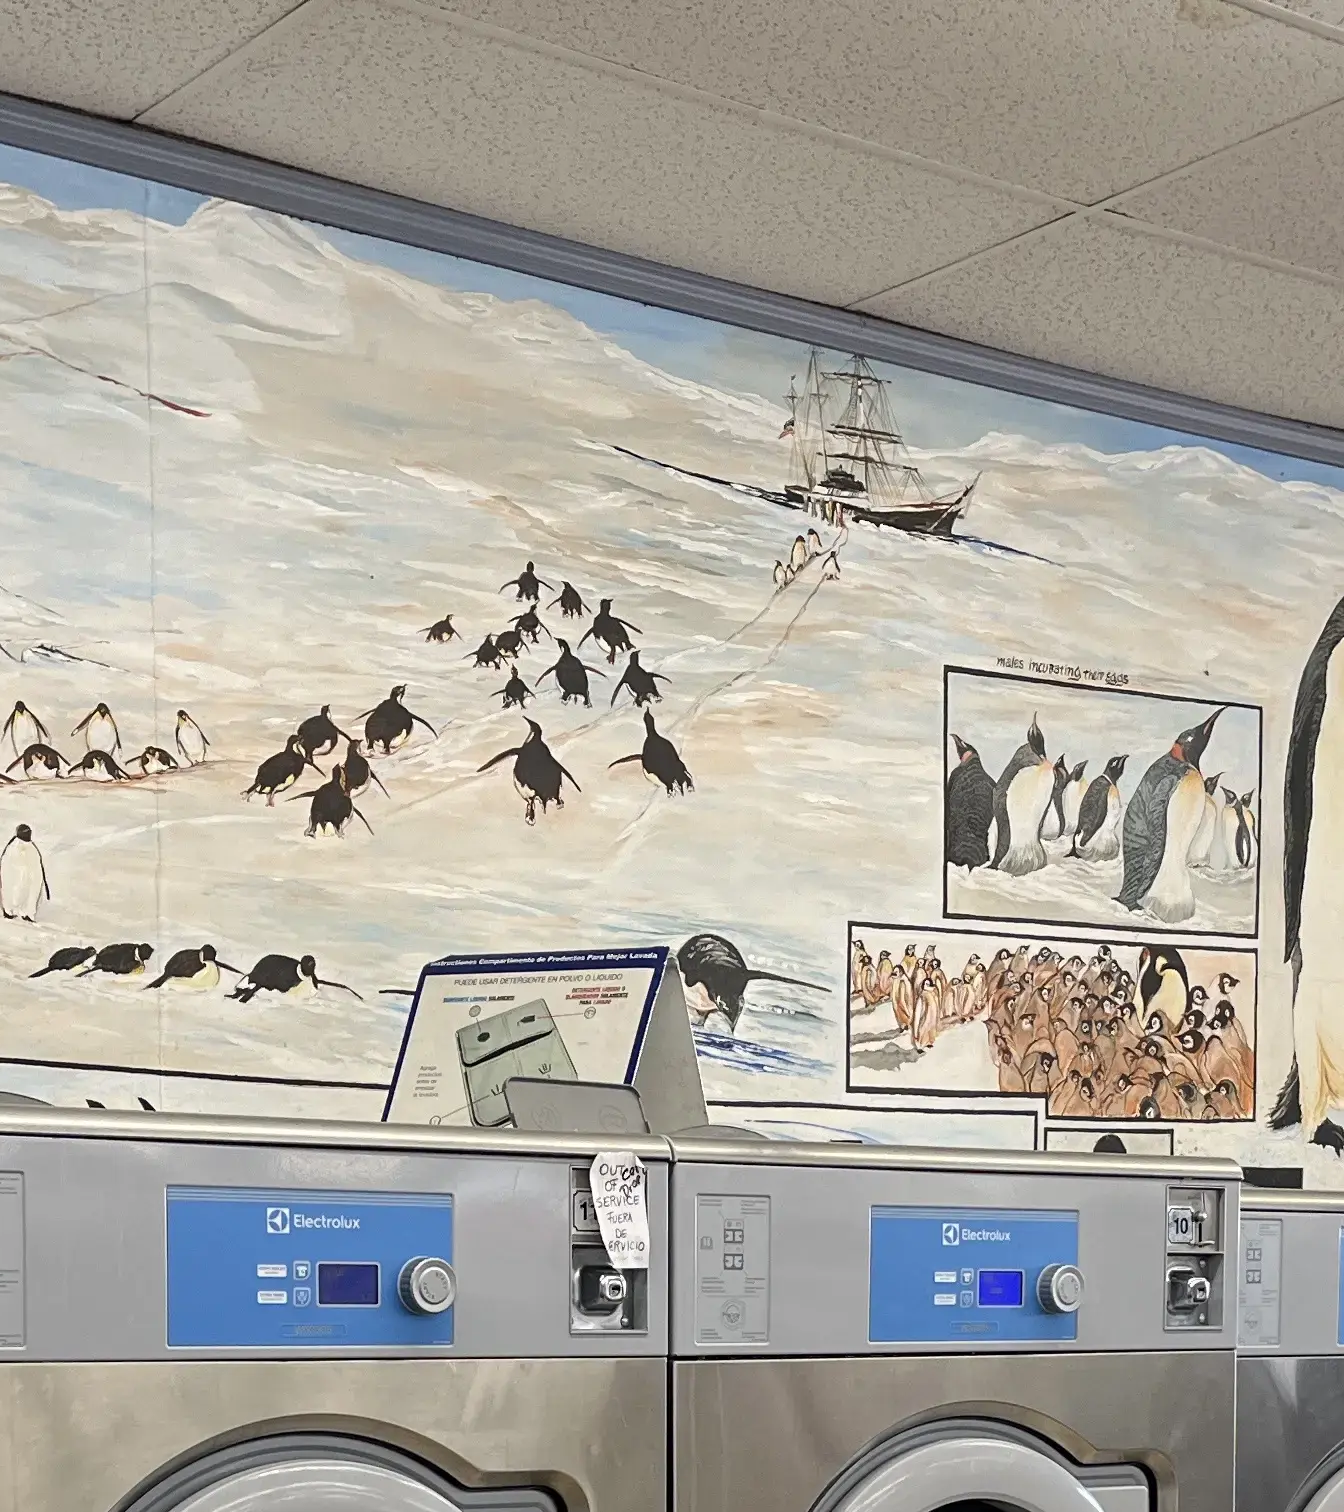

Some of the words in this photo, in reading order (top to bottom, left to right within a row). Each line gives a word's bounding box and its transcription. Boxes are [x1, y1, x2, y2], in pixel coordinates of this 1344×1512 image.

[996, 656, 1024, 669] males
[599, 1164, 625, 1176] OUT
[604, 1178, 619, 1192] OF
[596, 1195, 640, 1208] SERVICE
[293, 1214, 361, 1230] Electrolux
[606, 1211, 633, 1224] FUERA
[1174, 1217, 1189, 1235] 10
[615, 1228, 627, 1239] DE
[962, 1229, 1011, 1242] Electrolux
